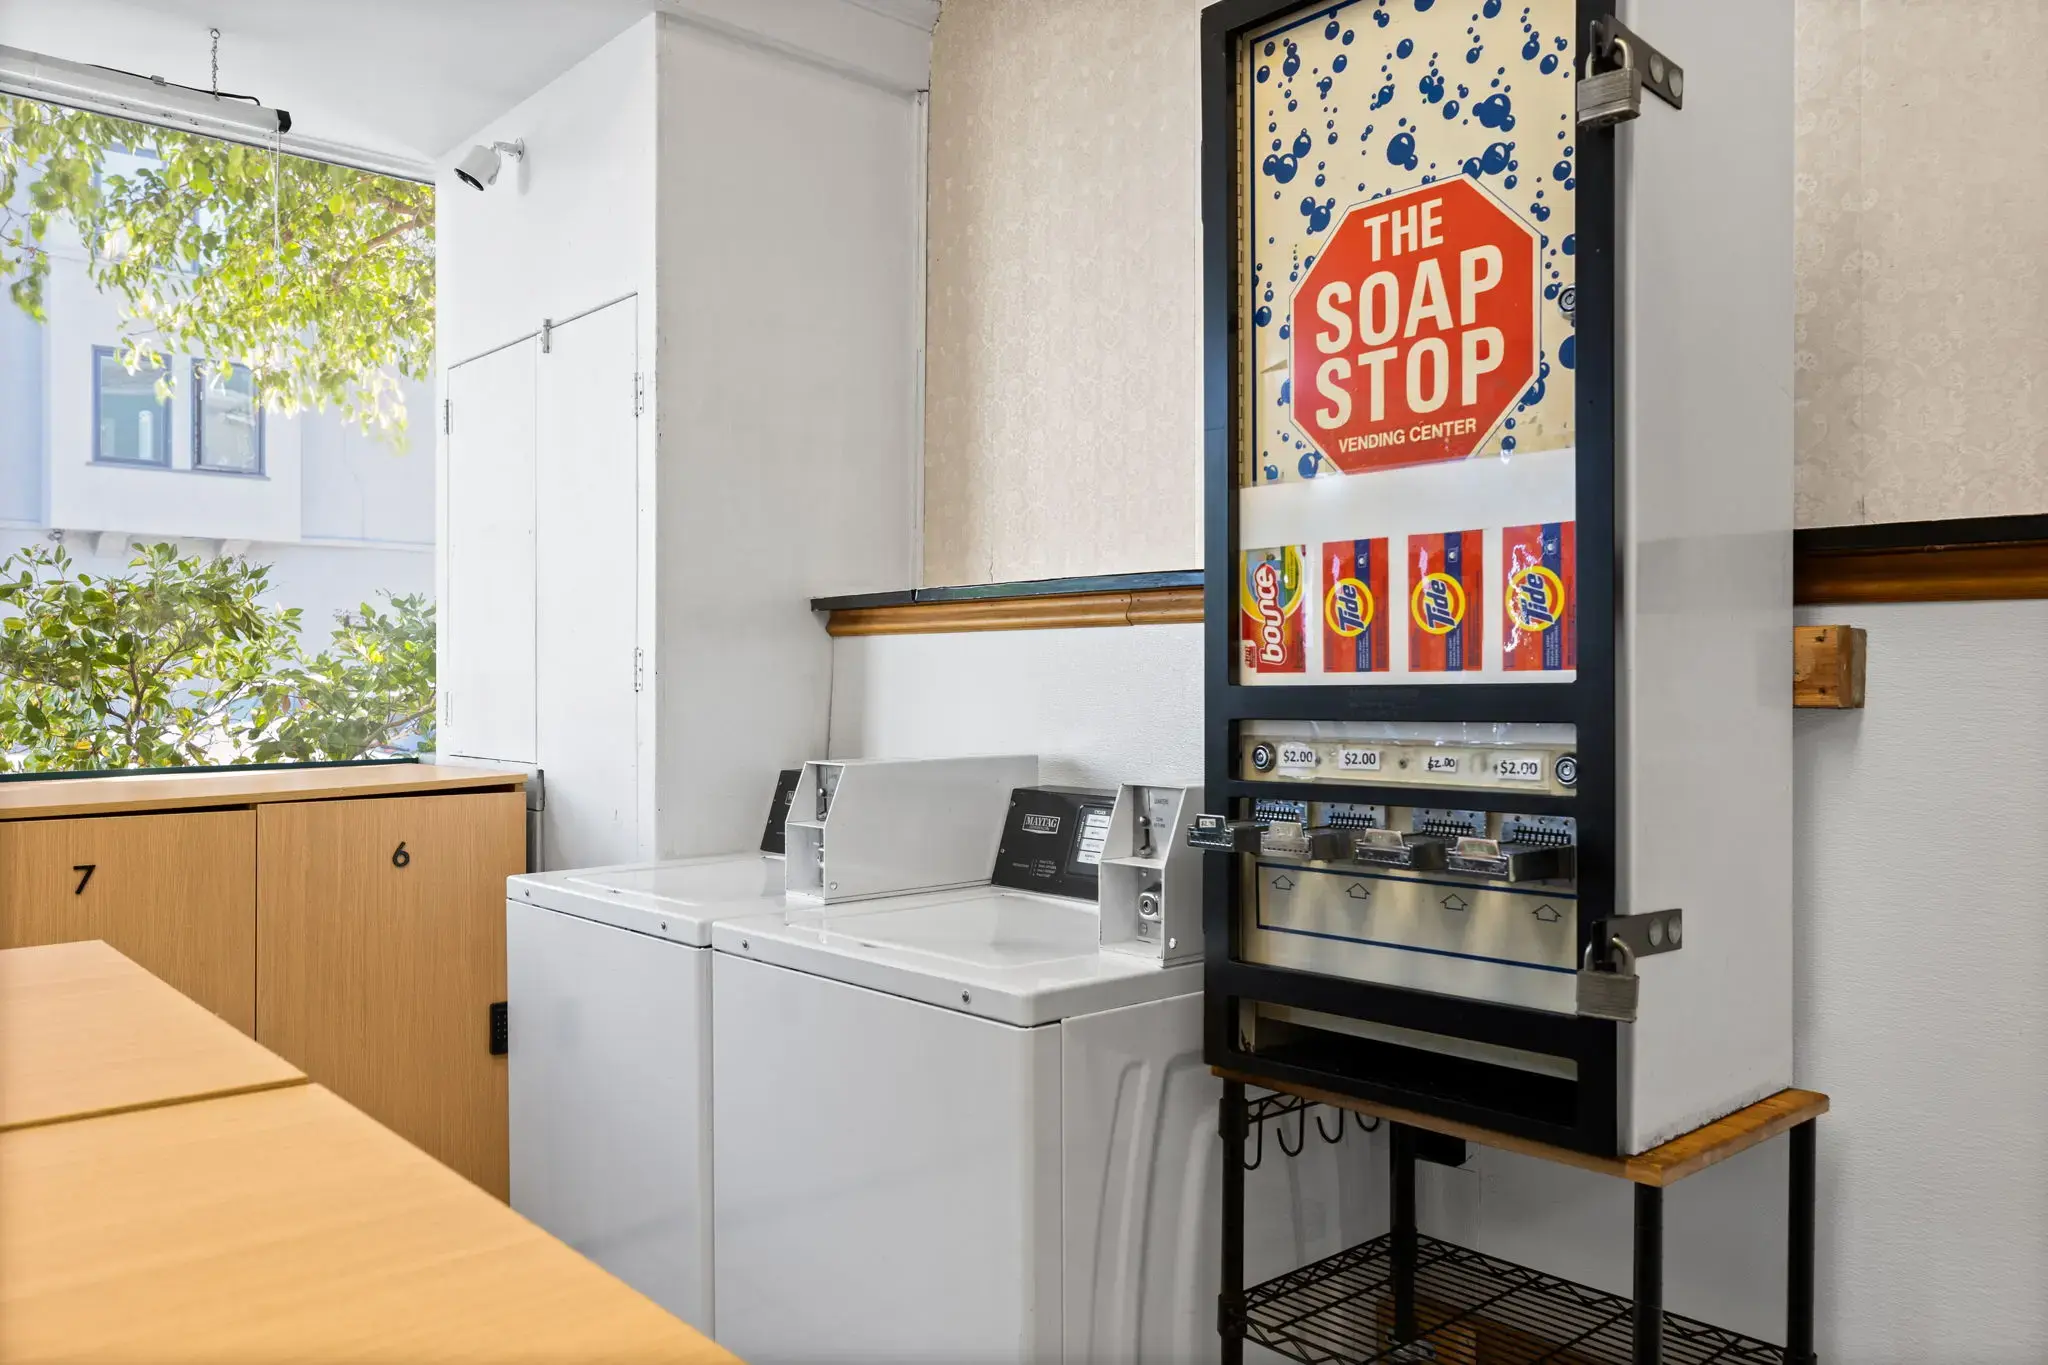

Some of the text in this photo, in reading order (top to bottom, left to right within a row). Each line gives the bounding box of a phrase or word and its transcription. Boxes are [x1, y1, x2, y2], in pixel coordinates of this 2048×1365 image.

[1364, 197, 1444, 262] THE
[1316, 244, 1504, 355] SOAP
[1315, 326, 1505, 430] STOP
[1338, 417, 1477, 454] VENDING CENTER
[1254, 564, 1286, 663] bounce
[1337, 584, 1365, 632] Tide
[1423, 580, 1456, 629] Tide
[1520, 573, 1553, 625] Tide
[1283, 750, 1313, 764] $2.00
[1344, 752, 1376, 765] $2.00
[1428, 756, 1456, 771] $2.00
[1500, 760, 1538, 775] $2.00
[1025, 816, 1058, 828] MAYTAG
[391, 841, 410, 867] 6
[73, 864, 96, 894] 7
